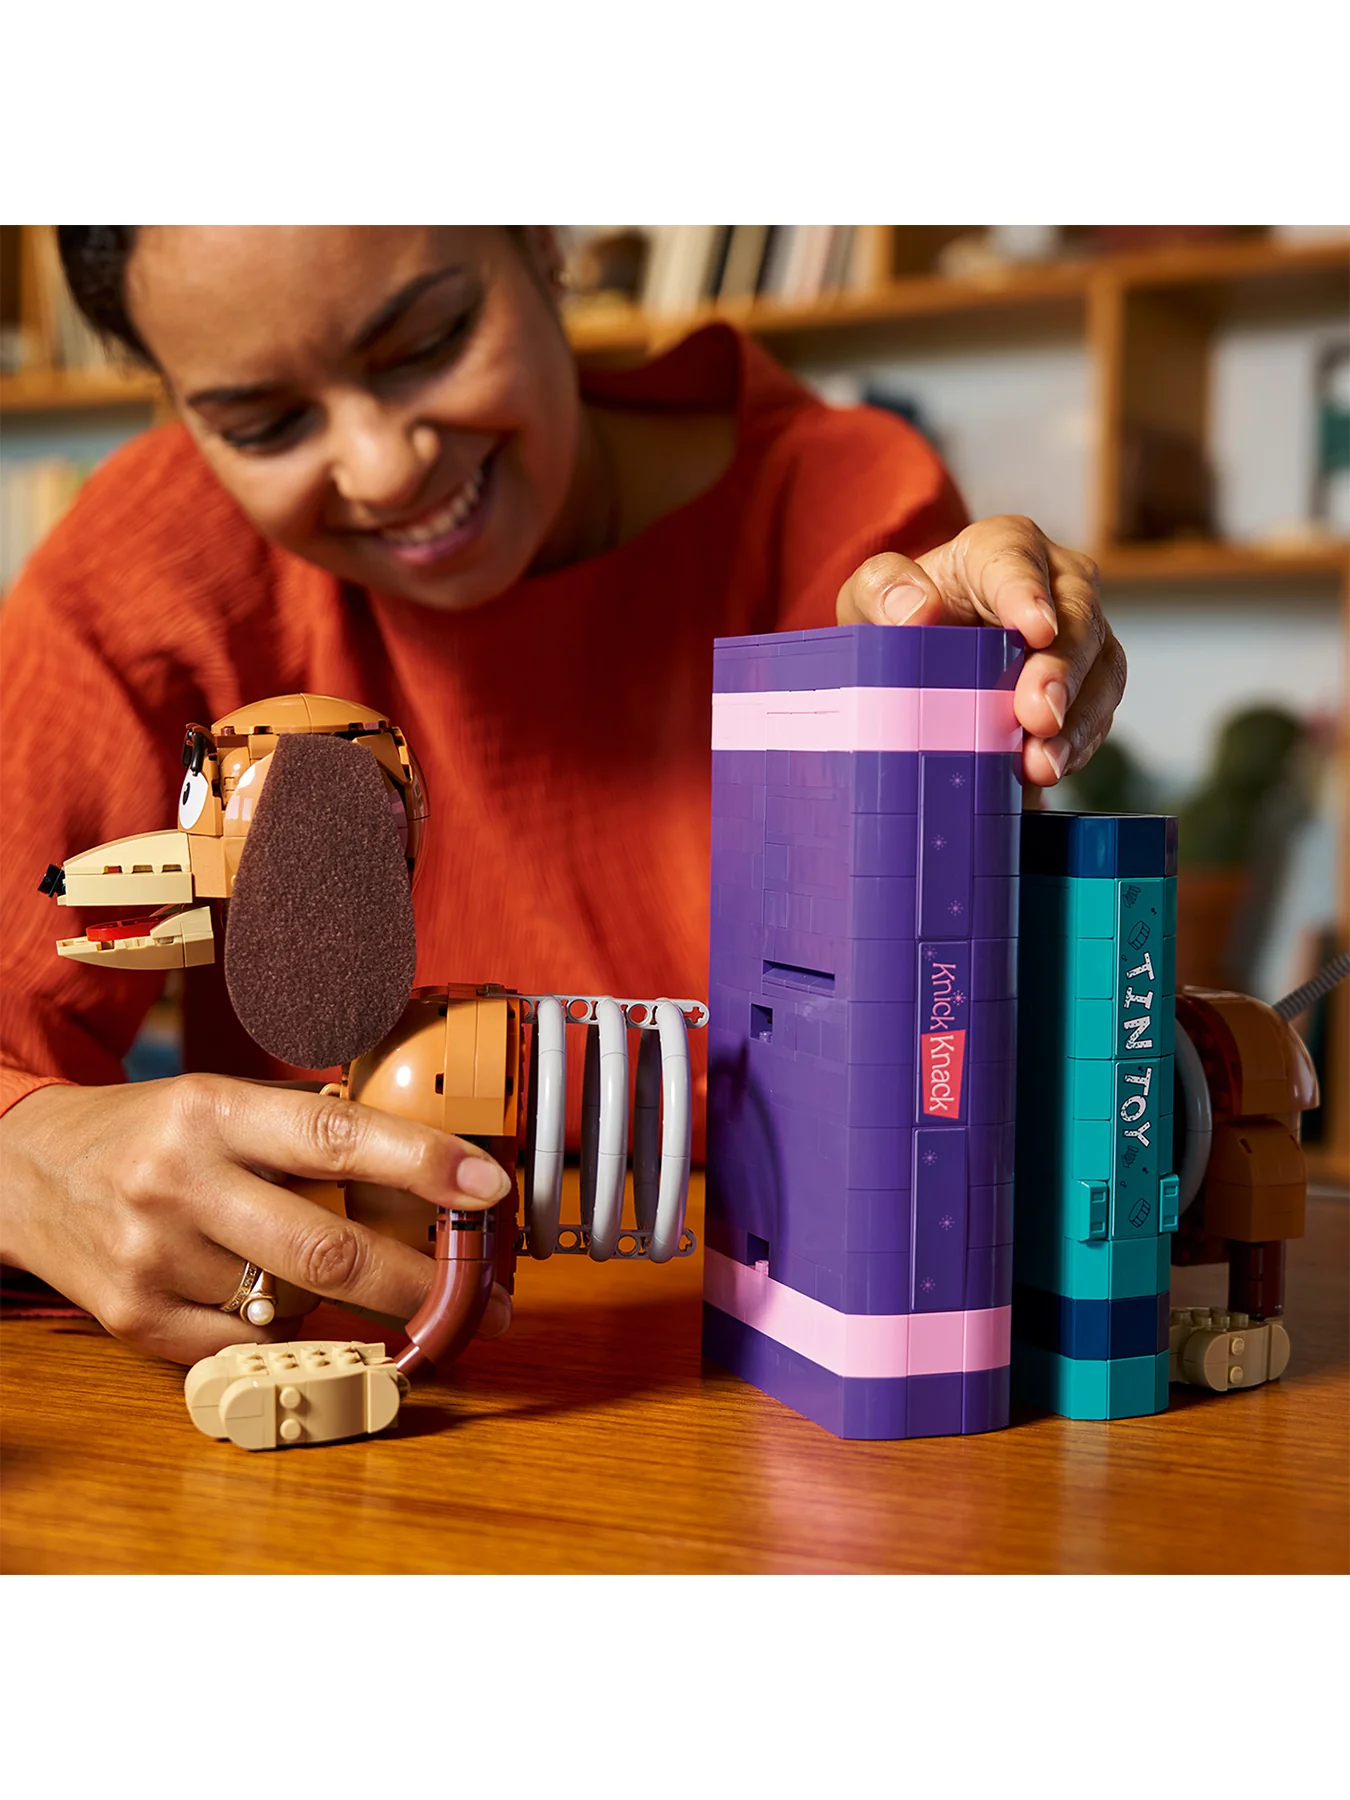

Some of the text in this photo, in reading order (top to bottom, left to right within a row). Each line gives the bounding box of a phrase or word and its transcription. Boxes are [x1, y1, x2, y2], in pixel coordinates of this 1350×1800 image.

[929, 962, 957, 1111] Knick Knack
[1120, 952, 1155, 1147] TIN TOY
